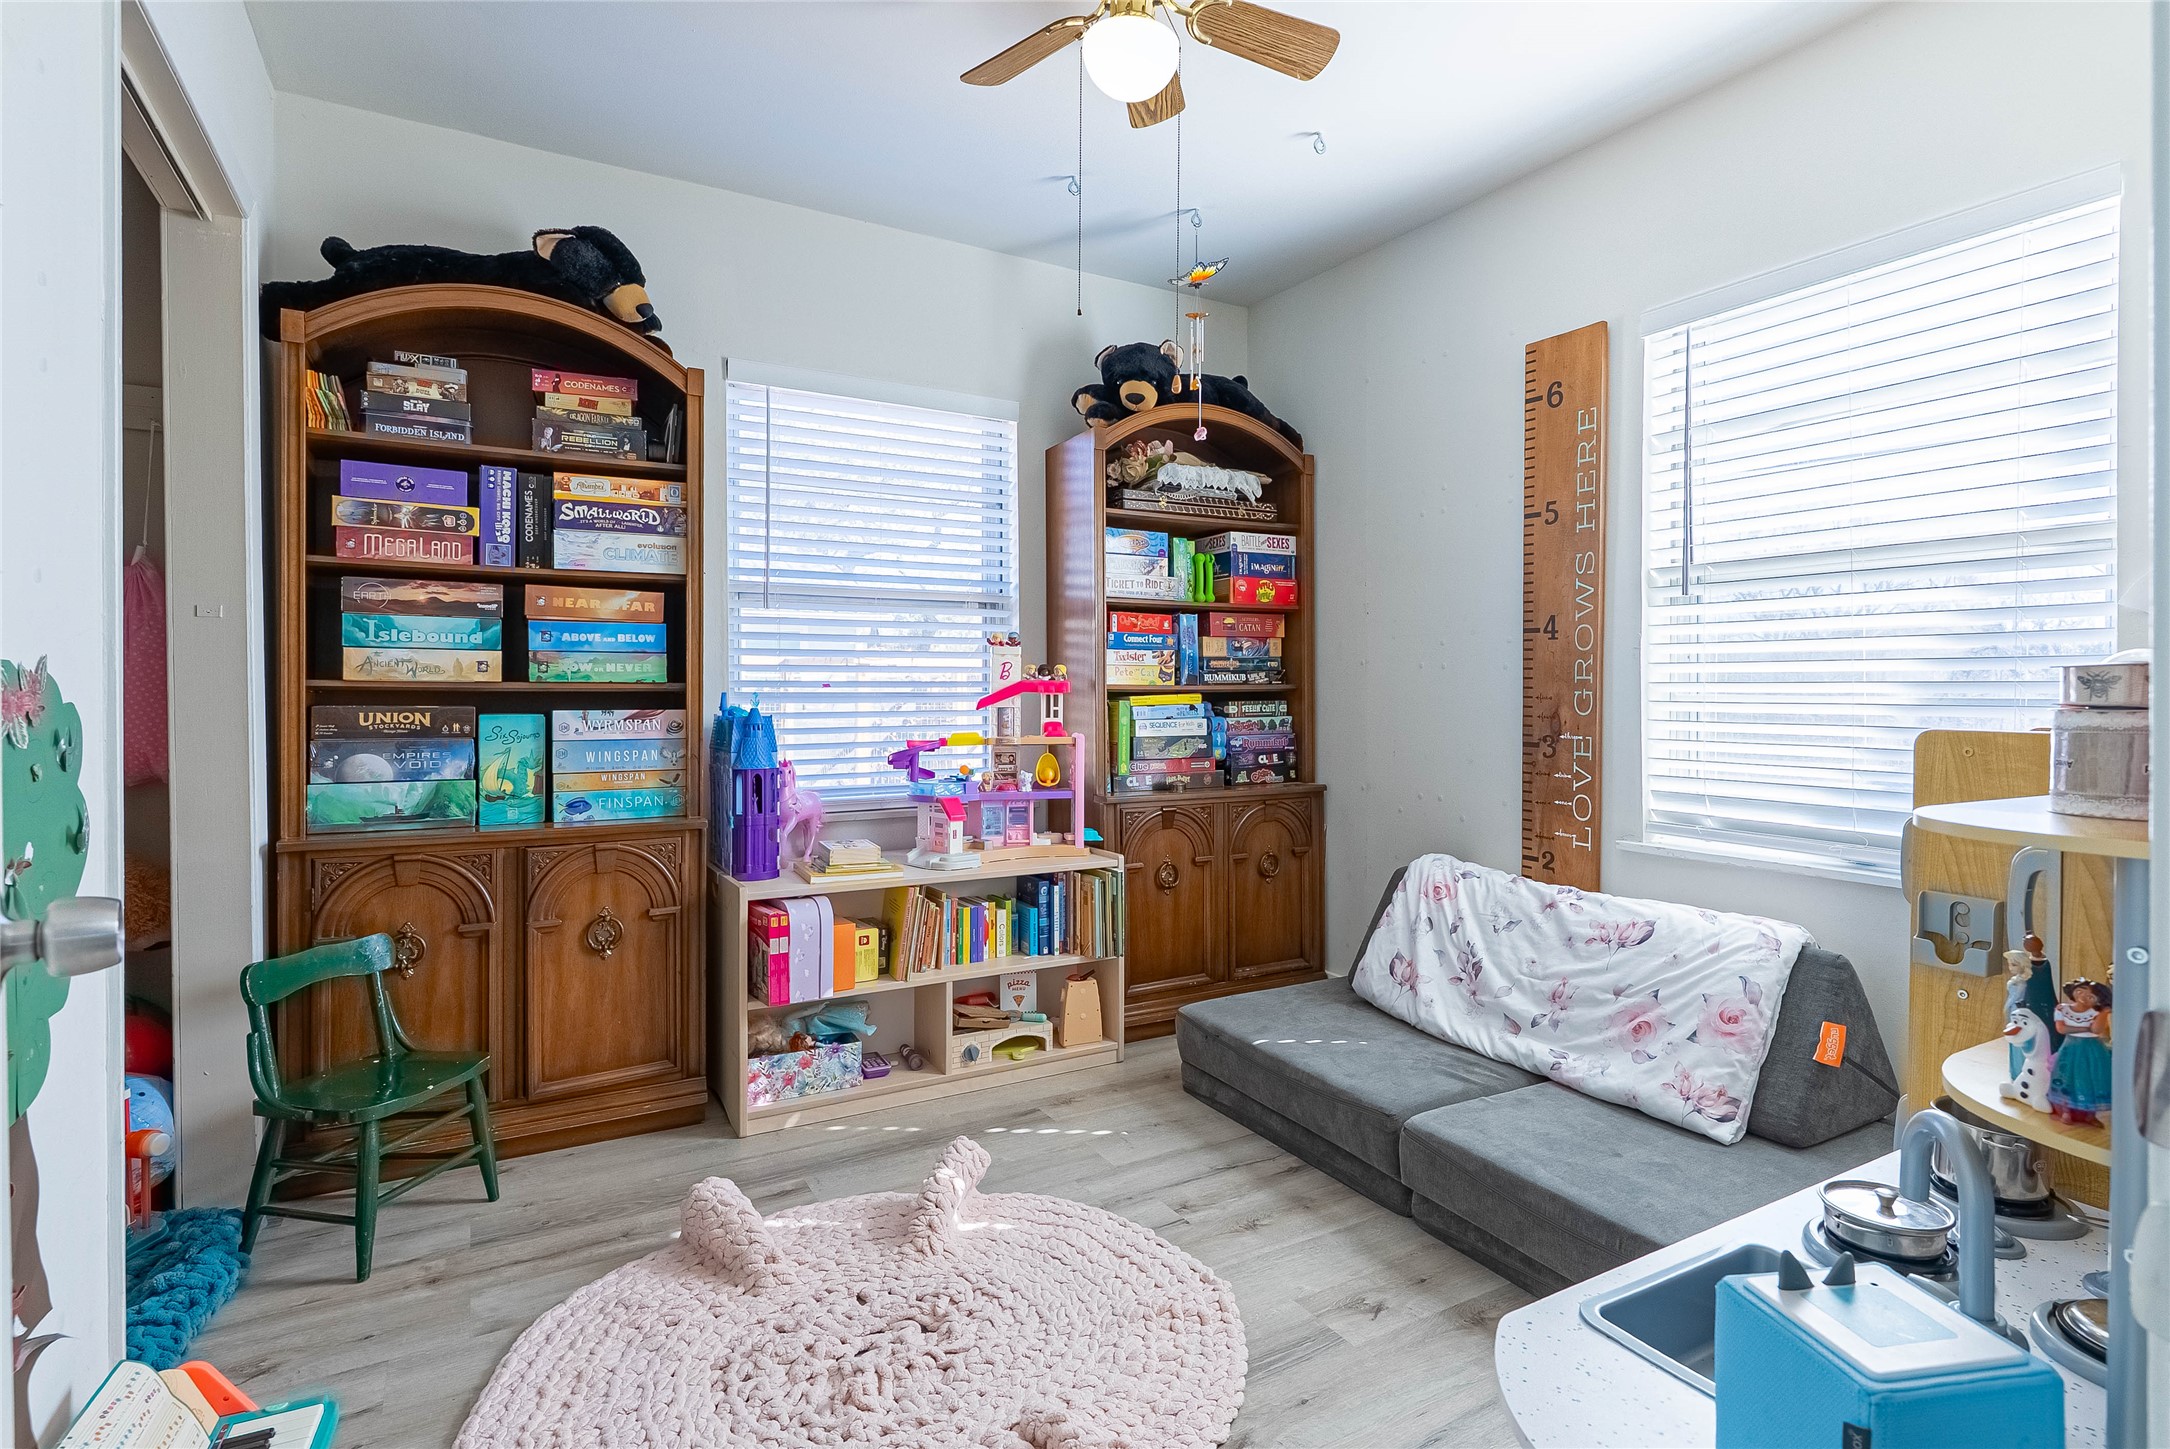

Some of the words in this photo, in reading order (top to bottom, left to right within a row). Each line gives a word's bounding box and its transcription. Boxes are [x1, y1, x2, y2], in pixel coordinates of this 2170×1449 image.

[564, 380, 620, 393] CODENAMES
[1546, 380, 1564, 409] 6
[403, 400, 430, 413] SLAY
[374, 422, 427, 437] FORBIDDEN
[429, 429, 465, 441] ISLAND
[561, 434, 618, 447] REBELLION
[1576, 406, 1597, 533] HERE
[502, 470, 512, 510] MACHI
[524, 490, 534, 543] CODENAMES
[1544, 500, 1559, 525] 5
[501, 511, 511, 544] KORO
[637, 542, 677, 551] evolution
[1208, 535, 1227, 550] SEXES
[1241, 534, 1262, 548] BATTLE
[1266, 536, 1291, 550] SEXES
[602, 547, 679, 564] CLIMATE
[1105, 577, 1136, 590] TICKET
[1145, 578, 1165, 591] RIDE
[353, 590, 392, 601] EARTH
[552, 596, 601, 609] NEAR
[622, 601, 656, 612] FAR
[362, 618, 483, 644] Islebound
[1238, 623, 1261, 632] CATAN
[1542, 614, 1559, 640] 4
[1573, 551, 1595, 716] GROWS
[561, 632, 601, 642] ABOVE
[617, 633, 656, 643] BELOW
[1123, 633, 1149, 643] Connect
[1149, 634, 1163, 644] Four
[1114, 650, 1147, 662] Twister
[560, 662, 593, 673] NOW
[606, 662, 653, 673] NEVER
[1000, 661, 1013, 680] B
[1114, 666, 1134, 677] Pete
[1140, 667, 1156, 677] Cat
[1204, 673, 1247, 682] RUMMIKUB
[358, 711, 431, 727] UNION
[582, 719, 662, 732] WYRMSPAN
[1149, 721, 1178, 729] SEQUENCE
[368, 723, 421, 731] STOCKYARDS
[484, 725, 508, 742] Six
[1542, 734, 1557, 759] 3
[382, 752, 452, 760] EMPIRES
[585, 749, 659, 763] WINGSPAN
[1258, 753, 1279, 764] CLUE
[393, 760, 442, 769] VOID
[1130, 762, 1149, 771] Clue
[601, 773, 646, 781] WINGSPAN
[1126, 775, 1153, 787] CLE
[1572, 736, 1592, 851] LOVE
[598, 795, 664, 808] FINSPAN
[1541, 851, 1556, 875] 2
[998, 923, 1006, 947] Colors
[1007, 978, 1031, 990] pizza
[1824, 1027, 1840, 1061] nugget
